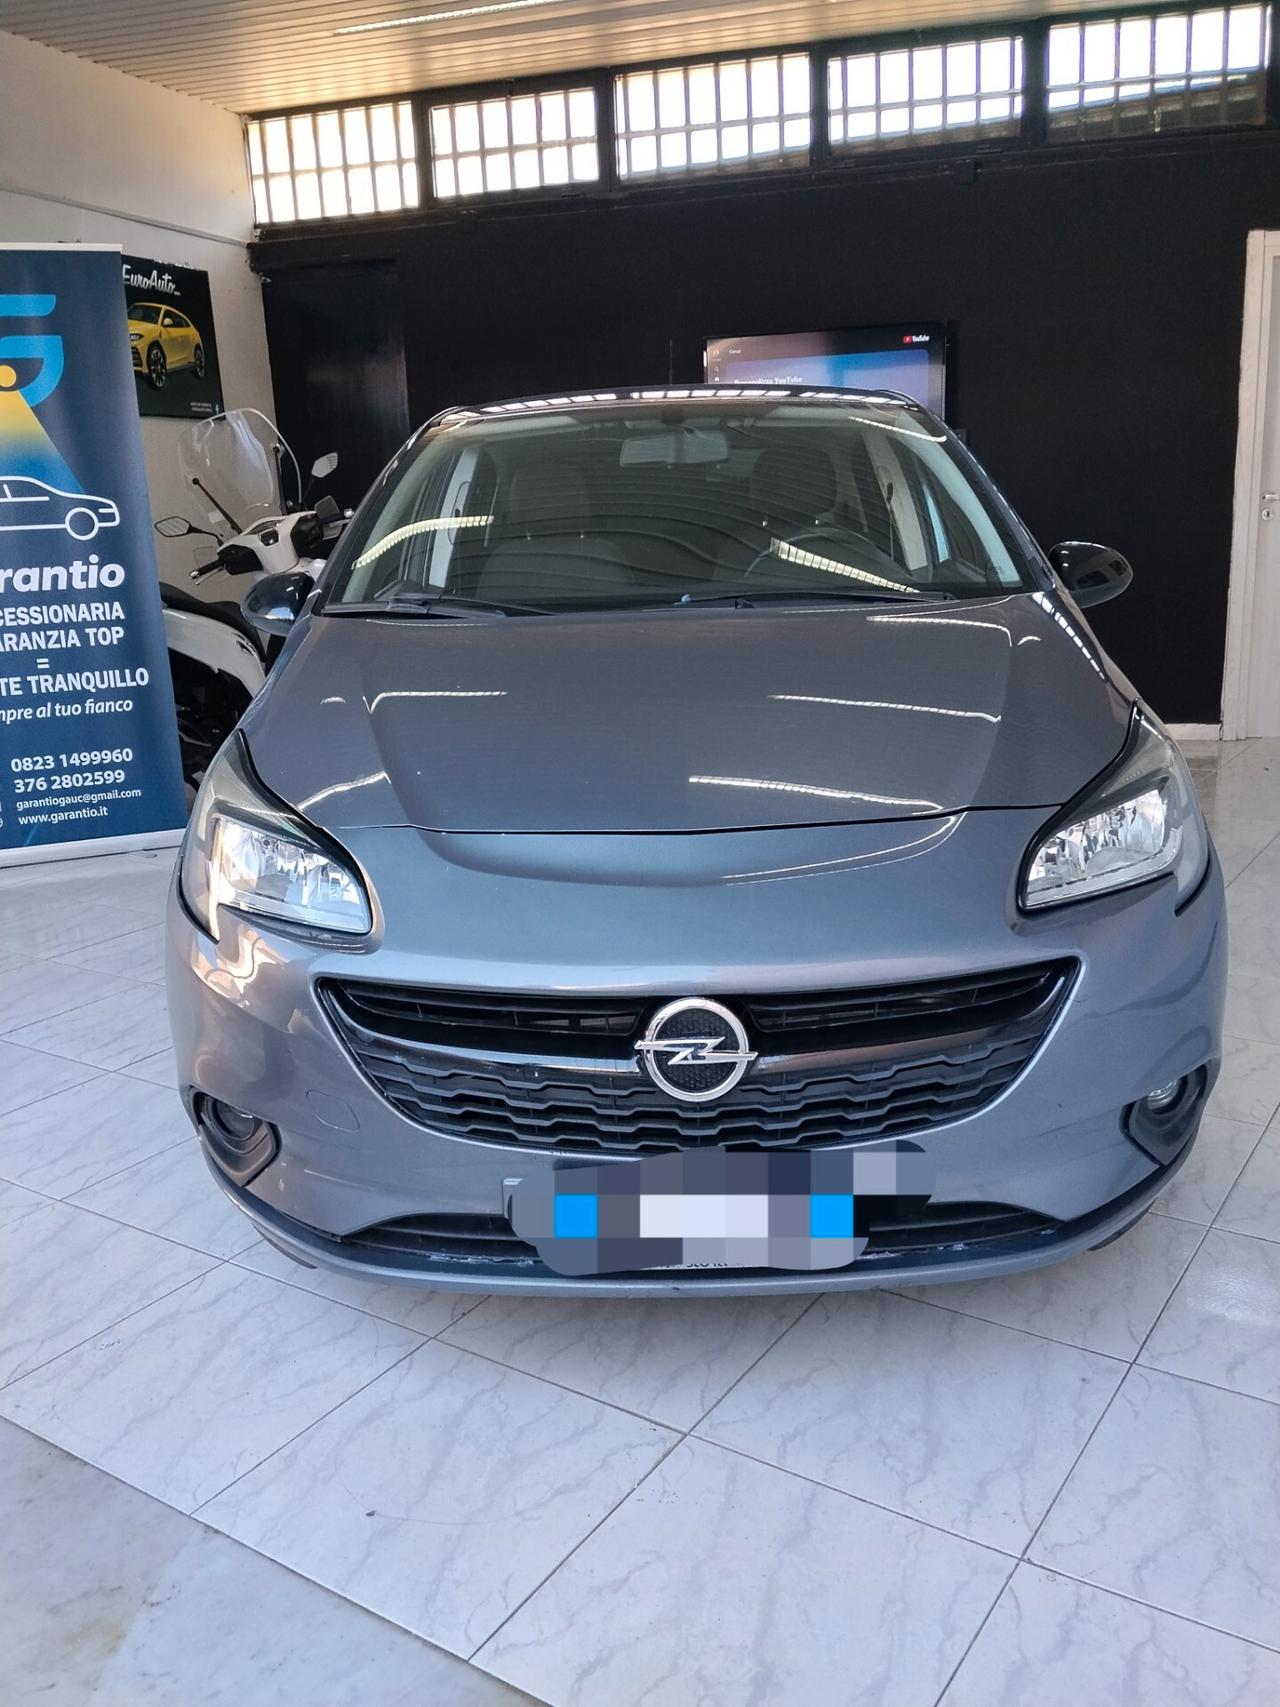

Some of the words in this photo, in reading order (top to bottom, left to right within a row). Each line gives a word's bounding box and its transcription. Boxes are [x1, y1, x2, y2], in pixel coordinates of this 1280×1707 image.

[122, 264, 176, 294] EuroAuto
[0, 601, 126, 627] ESSIONARIA
[85, 626, 124, 646] TOP
[27, 667, 149, 693] TRANQUILLO
[36, 702, 51, 718] al
[54, 702, 81, 717] tuo
[85, 698, 133, 714] fianco
[10, 755, 55, 772] 0823
[58, 748, 133, 768] 1499960
[14, 777, 47, 793] 376
[50, 769, 125, 790] 2802599
[16, 788, 141, 811] garantiogauc@gmail.com
[18, 805, 108, 825] www.garantio.it
